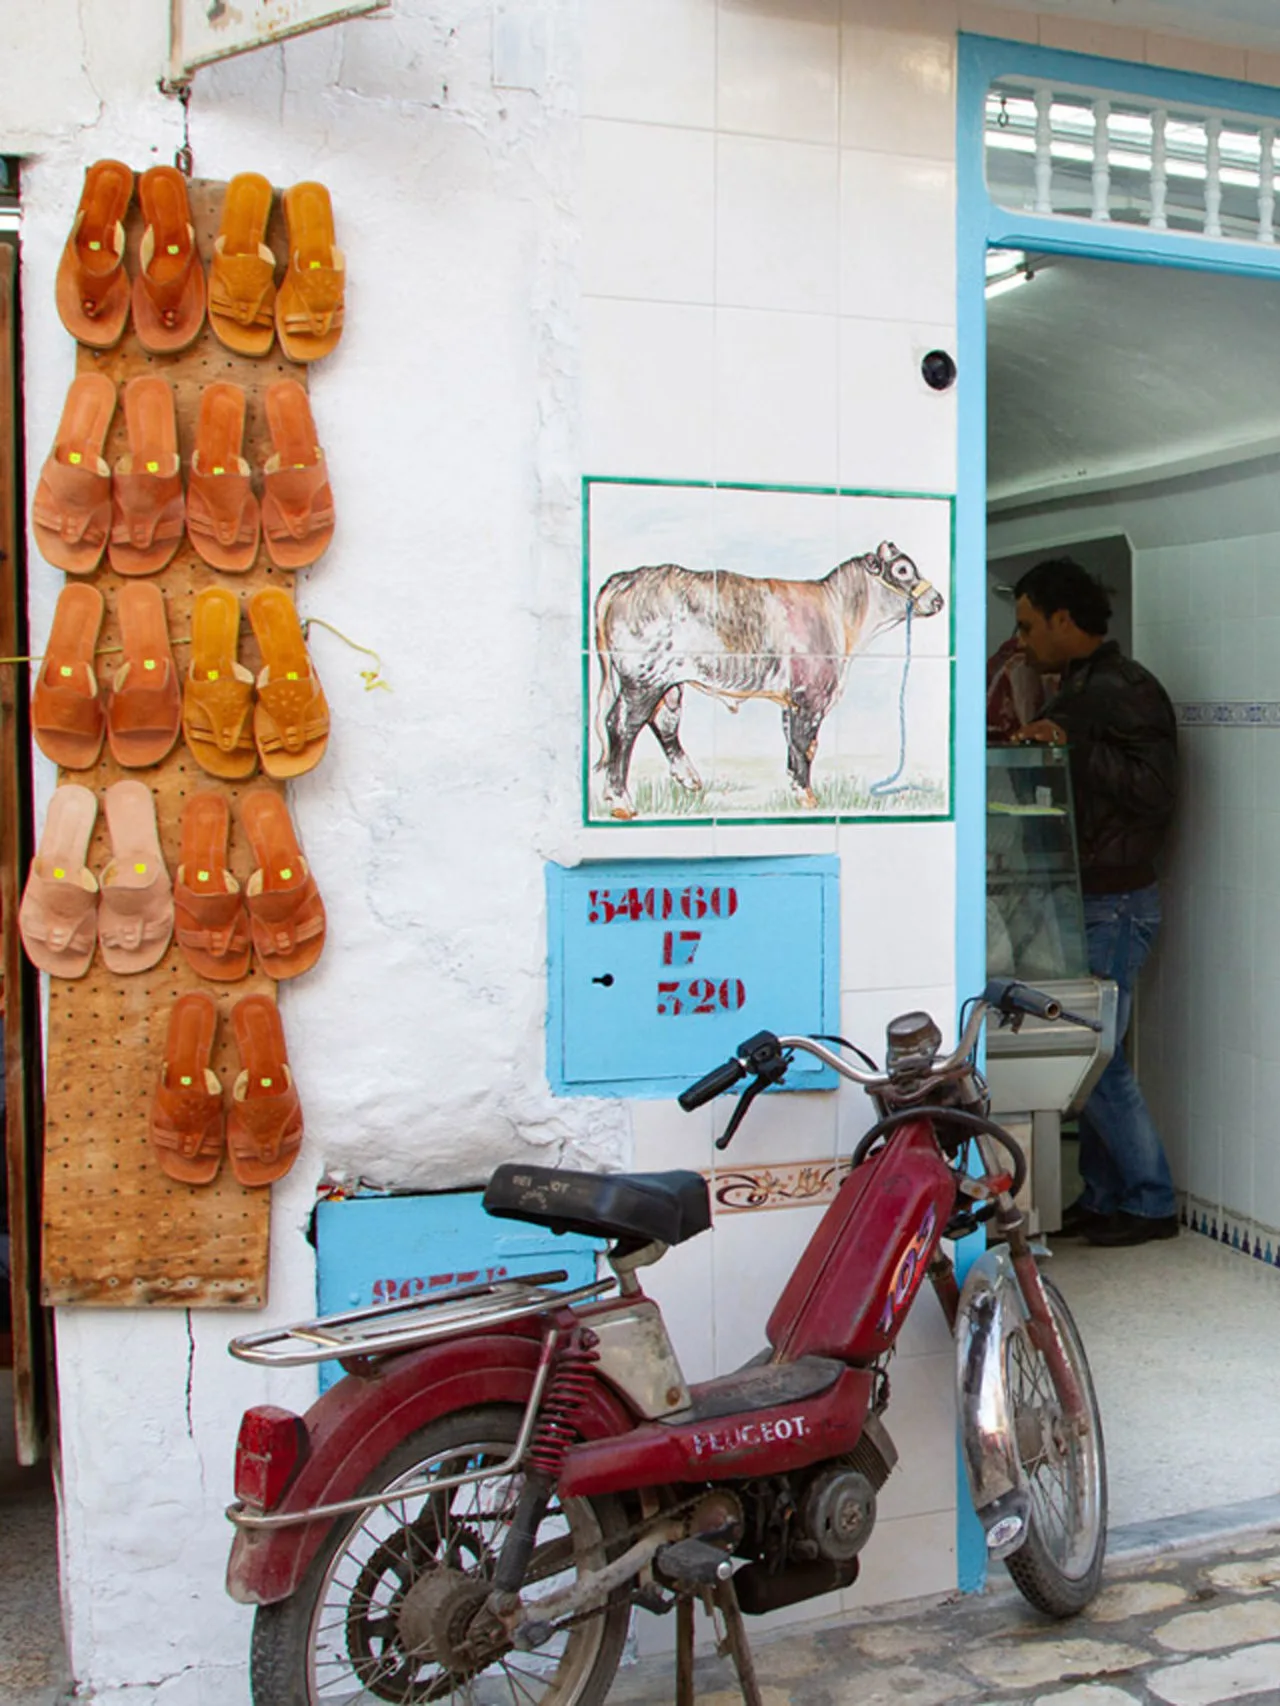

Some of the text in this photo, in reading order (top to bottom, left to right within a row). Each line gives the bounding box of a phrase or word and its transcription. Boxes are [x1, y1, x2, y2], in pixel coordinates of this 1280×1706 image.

[588, 885, 739, 925] 54060
[663, 930, 703, 966] 17
[656, 978, 747, 1017] 520
